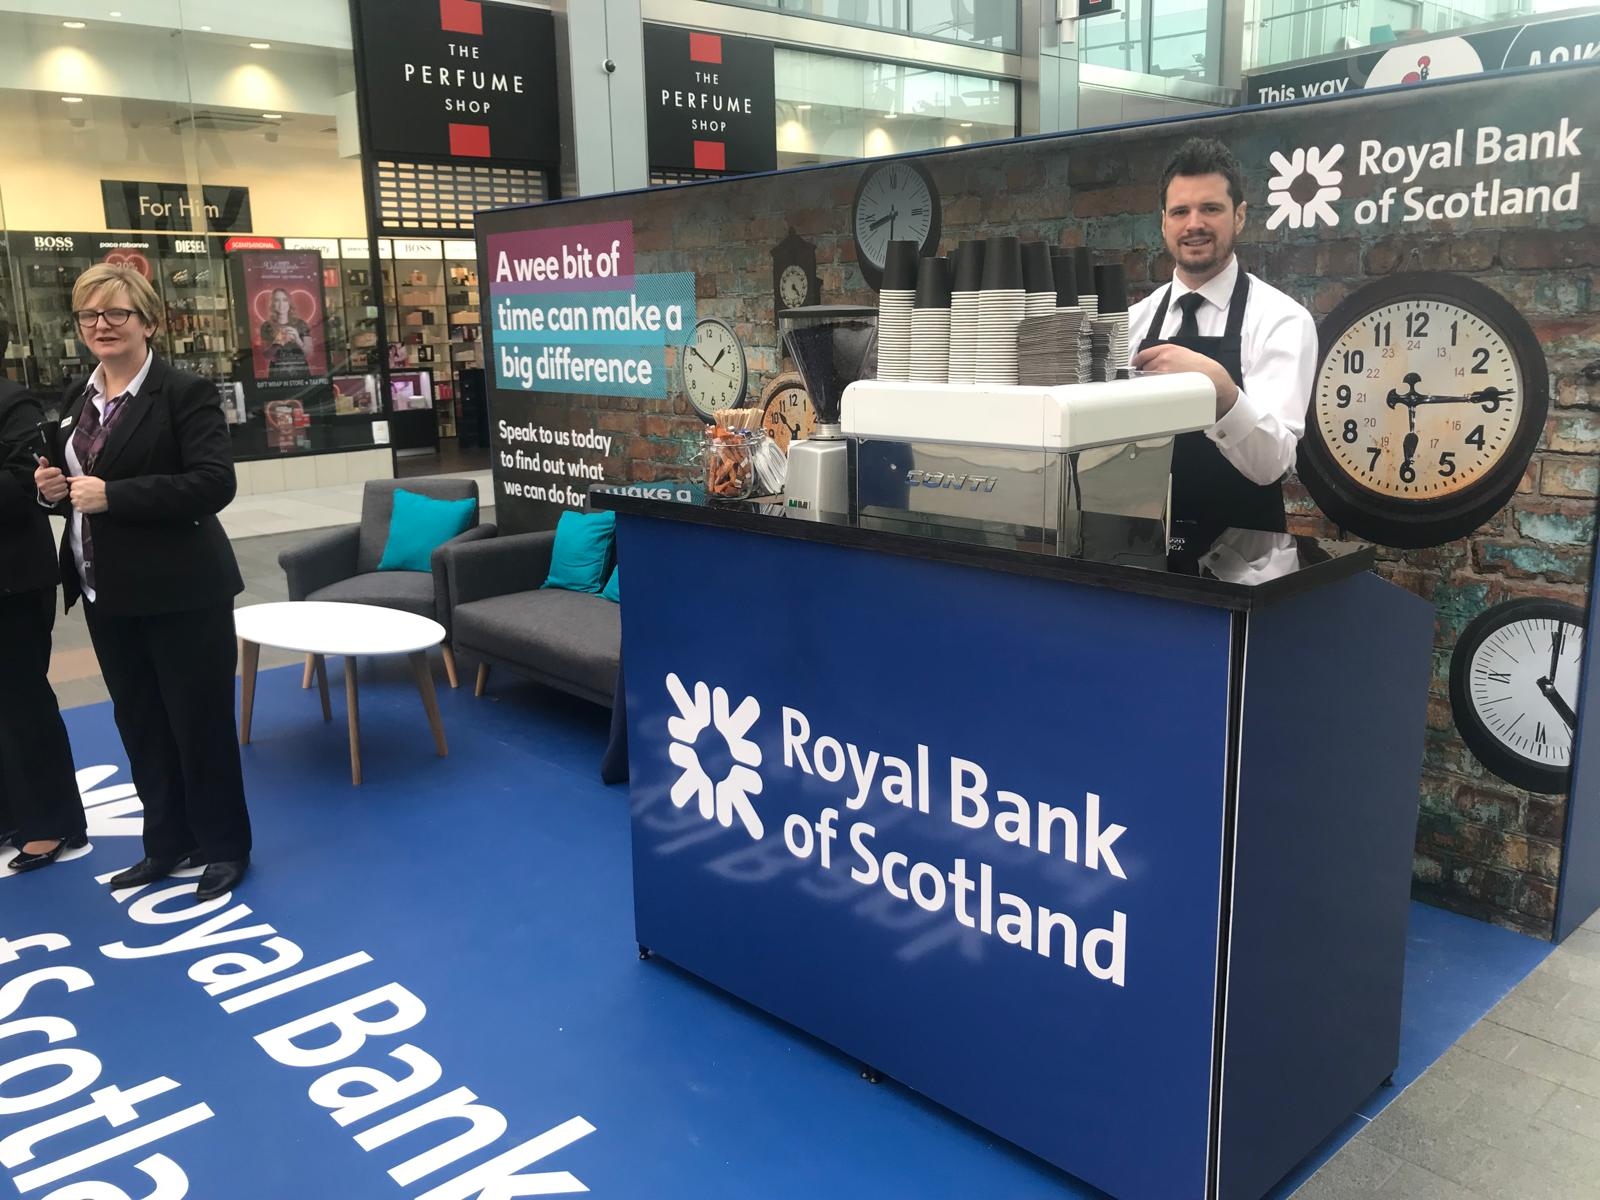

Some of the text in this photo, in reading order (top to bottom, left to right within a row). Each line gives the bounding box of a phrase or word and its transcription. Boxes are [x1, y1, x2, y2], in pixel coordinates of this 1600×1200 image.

[449, 44, 480, 59] THE
[404, 63, 525, 94] PERFUME
[695, 72, 719, 85] THE
[445, 99, 491, 114] SHOP
[661, 89, 752, 114] PERFUME
[1259, 87, 1296, 105] This
[692, 119, 727, 133] SHOP
[1358, 117, 1584, 184] Royal Bank
[138, 195, 220, 219] For Him
[1354, 172, 1581, 225] of Scotland
[34, 236, 73, 248] BOSS
[173, 240, 208, 254] DIESEL
[495, 240, 620, 282] A wee bit of
[498, 294, 682, 331] time can make a
[1406, 312, 1430, 337] 12
[1374, 321, 1391, 346] 11
[1407, 340, 1421, 351] 24
[1450, 321, 1458, 346] 1
[501, 346, 652, 388] big difference
[1342, 350, 1364, 374] 10
[1471, 348, 1490, 374] 2
[1366, 369, 1380, 379] 22
[789, 393, 798, 407] 12
[1336, 385, 1351, 408] 9
[771, 412, 779, 424] 10
[499, 420, 611, 456] Speak to us today
[1342, 419, 1358, 443] 8
[1465, 425, 1485, 450] 4
[500, 450, 604, 482] to find out what
[1366, 447, 1382, 472] 7
[1399, 460, 1416, 483] 6
[1438, 452, 1456, 477] 5
[503, 482, 587, 508] we can do for
[782, 705, 1128, 880] Royal Bank
[784, 808, 839, 870] of
[849, 822, 1128, 988] Scotland
[0, 965, 216, 1200] Scotla
[253, 981, 597, 1200] Bank
